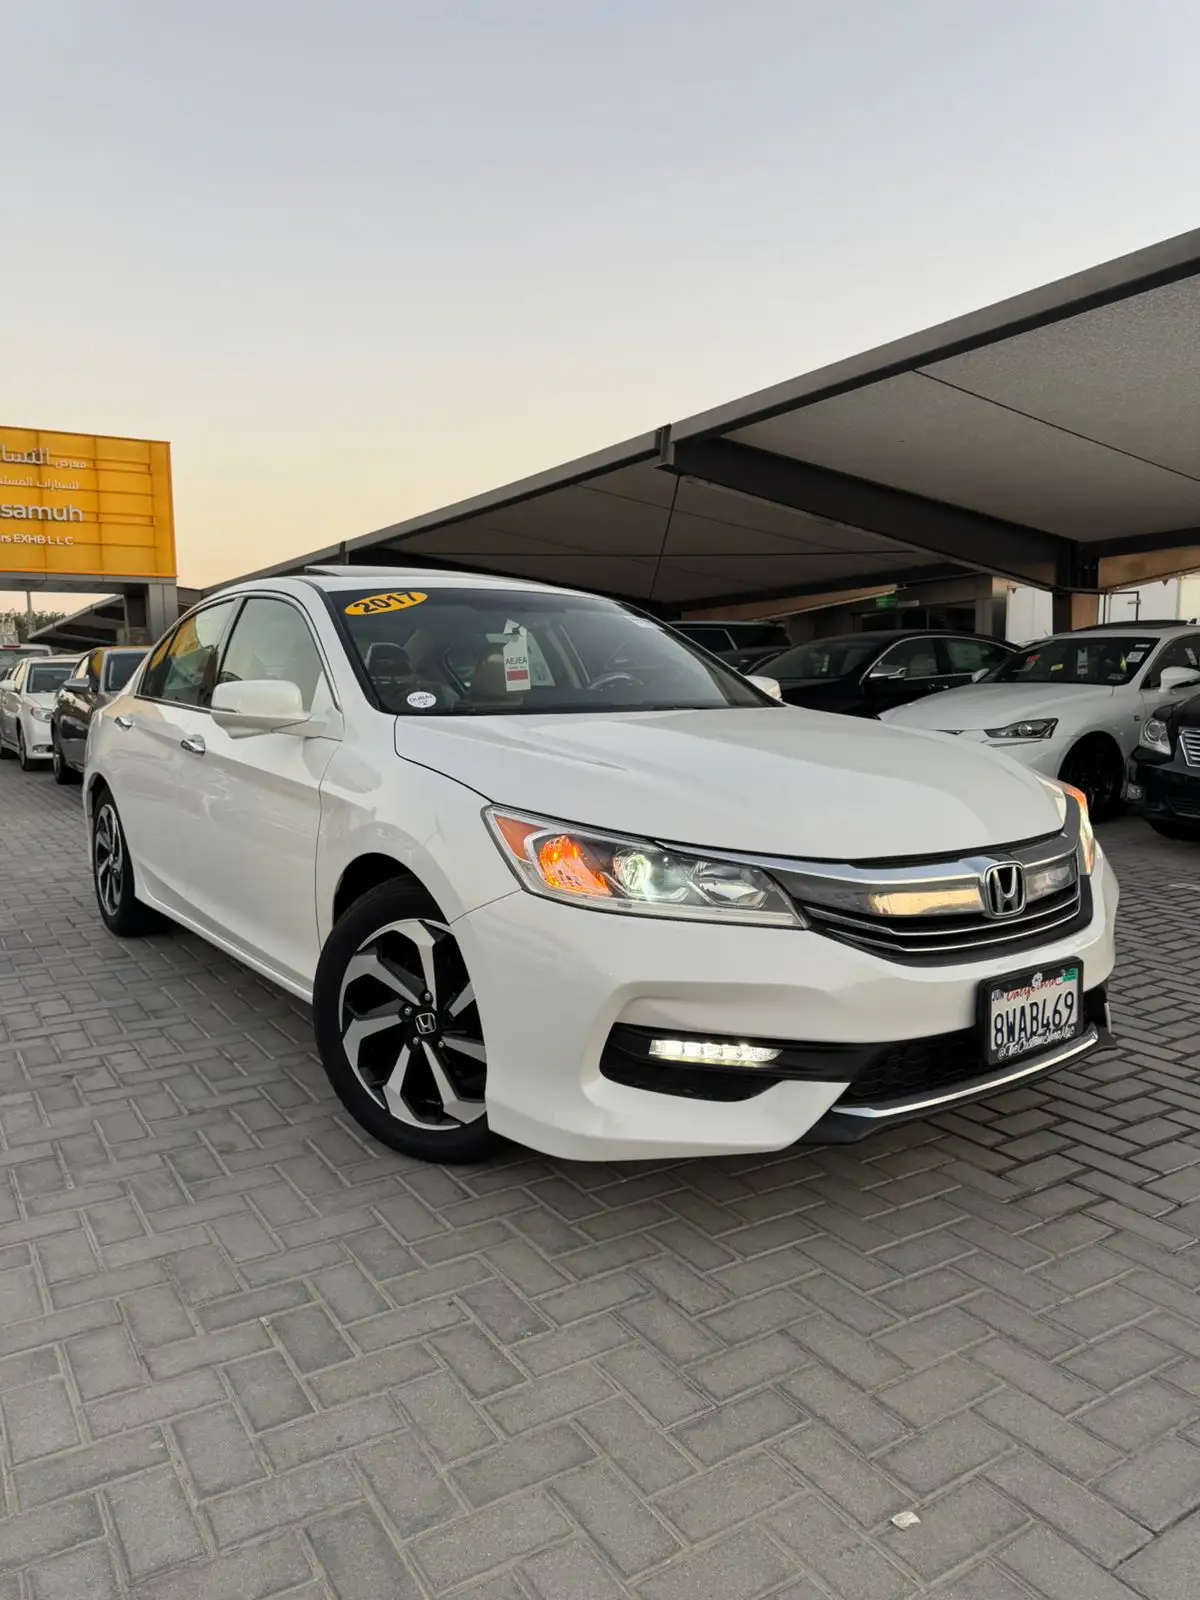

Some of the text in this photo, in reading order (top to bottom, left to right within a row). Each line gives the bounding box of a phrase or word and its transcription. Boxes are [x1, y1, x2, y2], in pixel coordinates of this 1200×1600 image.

[55, 459, 87, 469] معرض
[36, 478, 79, 491] للسيارات
[13, 533, 46, 544] EXHB
[353, 591, 418, 613] 2017
[994, 990, 1075, 1048] 8WAB469
